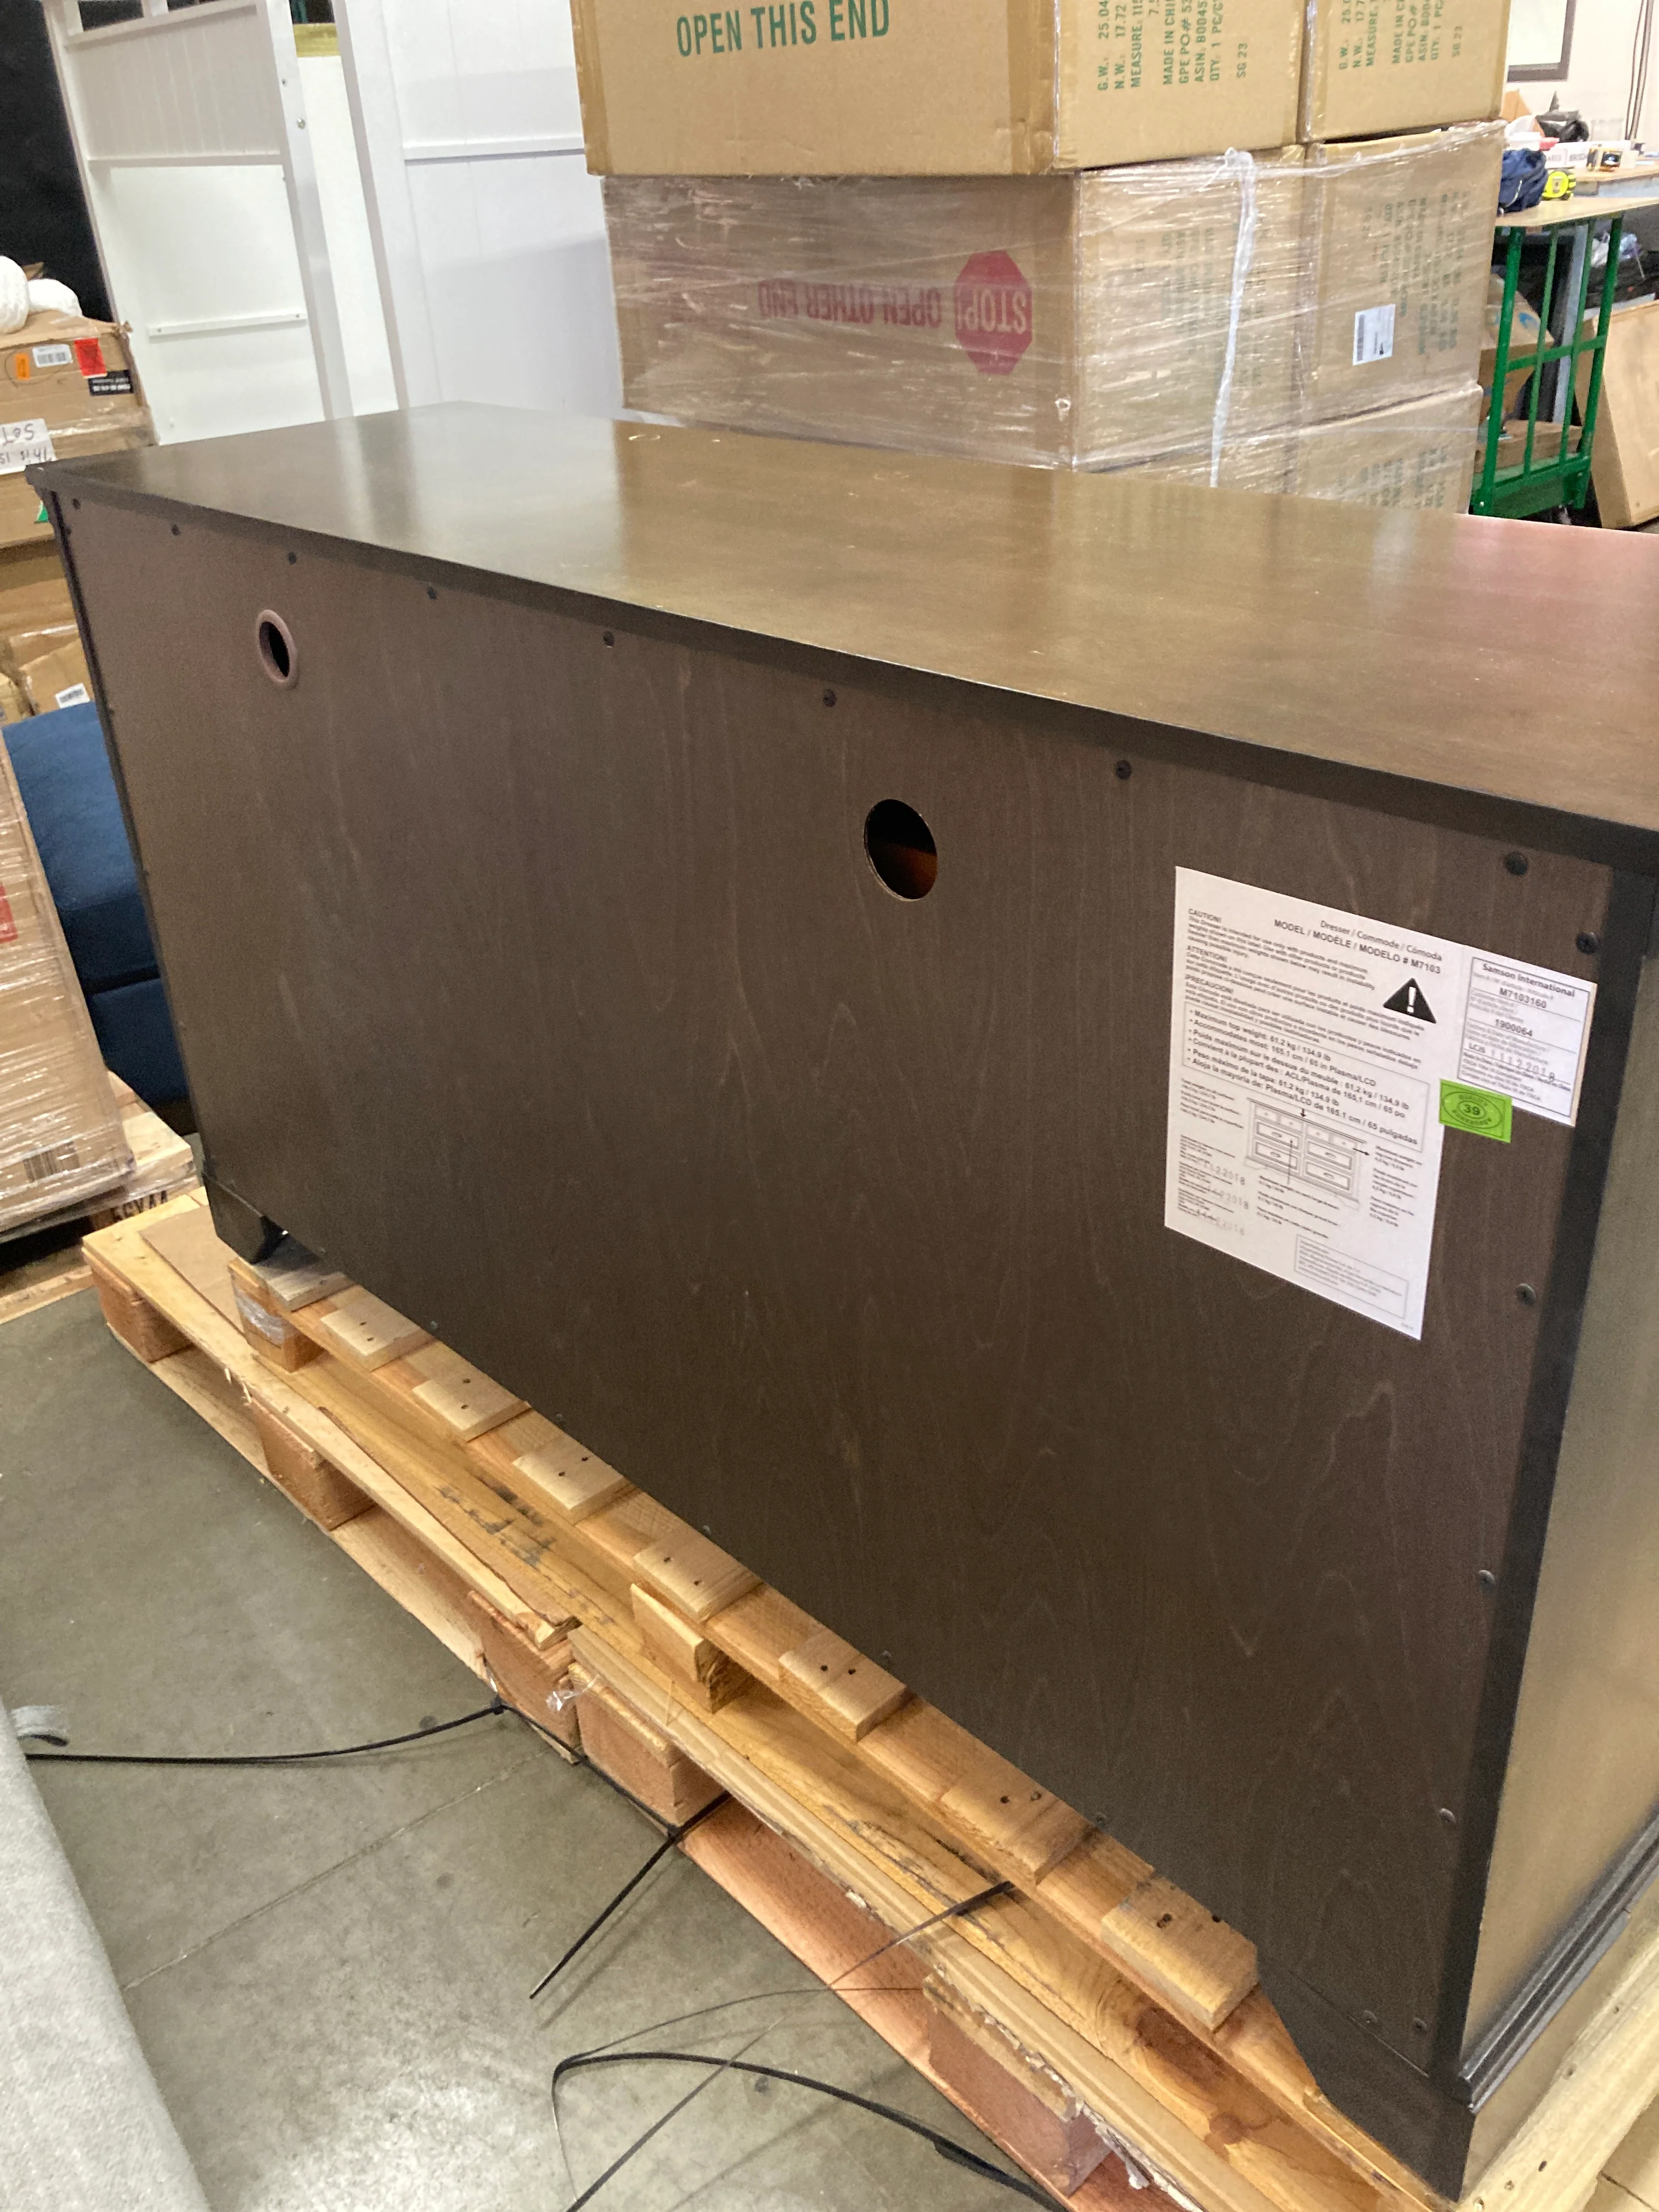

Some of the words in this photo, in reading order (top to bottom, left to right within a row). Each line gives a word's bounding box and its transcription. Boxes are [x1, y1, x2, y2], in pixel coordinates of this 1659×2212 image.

[676, 9, 742, 57] OPEN
[751, 1, 817, 49] THIS
[828, 0, 889, 42] END
[1165, 0, 1176, 26] CHI
[1164, 30, 1175, 44] IN
[1238, 43, 1248, 58] 23
[1163, 48, 1174, 84] MADE
[1179, 58, 1190, 84] GPE
[1274, 918, 1306, 935] MODEL
[1359, 944, 1400, 962] MODELO
[1410, 958, 1441, 974] M7103
[1321, 919, 1350, 935] Dresser
[1357, 930, 1400, 949] Commode
[1482, 963, 1516, 979] Samson
[1517, 973, 1575, 997] International
[1499, 987, 1547, 1008] M7103160
[1194, 1009, 1227, 1026] Maximum
[1229, 1021, 1240, 1032] top
[1286, 1041, 1295, 1051] kg
[1323, 1053, 1330, 1062] lb
[1194, 1019, 1247, 1042] Accommodates
[1292, 1053, 1304, 1062] cm
[1309, 1058, 1318, 1067] 65
[1494, 1018, 1533, 1037] 1900064
[1193, 1029, 1212, 1041] Poids
[1215, 1037, 1248, 1053] maximum
[1271, 1056, 1297, 1071] dessus
[1299, 1066, 1309, 1075] du
[1310, 1070, 1338, 1085] meuble
[1363, 1088, 1373, 1098] kg
[1401, 1101, 1409, 1110] lb
[1193, 1048, 1210, 1060] Peso
[1240, 1065, 1249, 1074] de
[1295, 1085, 1304, 1095] kg
[1331, 1097, 1339, 1106] lb
[1193, 1037, 1223, 1054] Convient
[1239, 1053, 1263, 1069] plupart
[1265, 1063, 1278, 1073] des
[1331, 1086, 1341, 1095] de
[1364, 1099, 1376, 1108] cm
[1383, 1104, 1393, 1114] 65
[1394, 1110, 1405, 1120] po
[1314, 1101, 1324, 1110] de
[1348, 1115, 1361, 1124] cm
[1367, 1121, 1378, 1130] 65
[1379, 1125, 1418, 1146] pulgadas
[1464, 1103, 1480, 1115] 39
